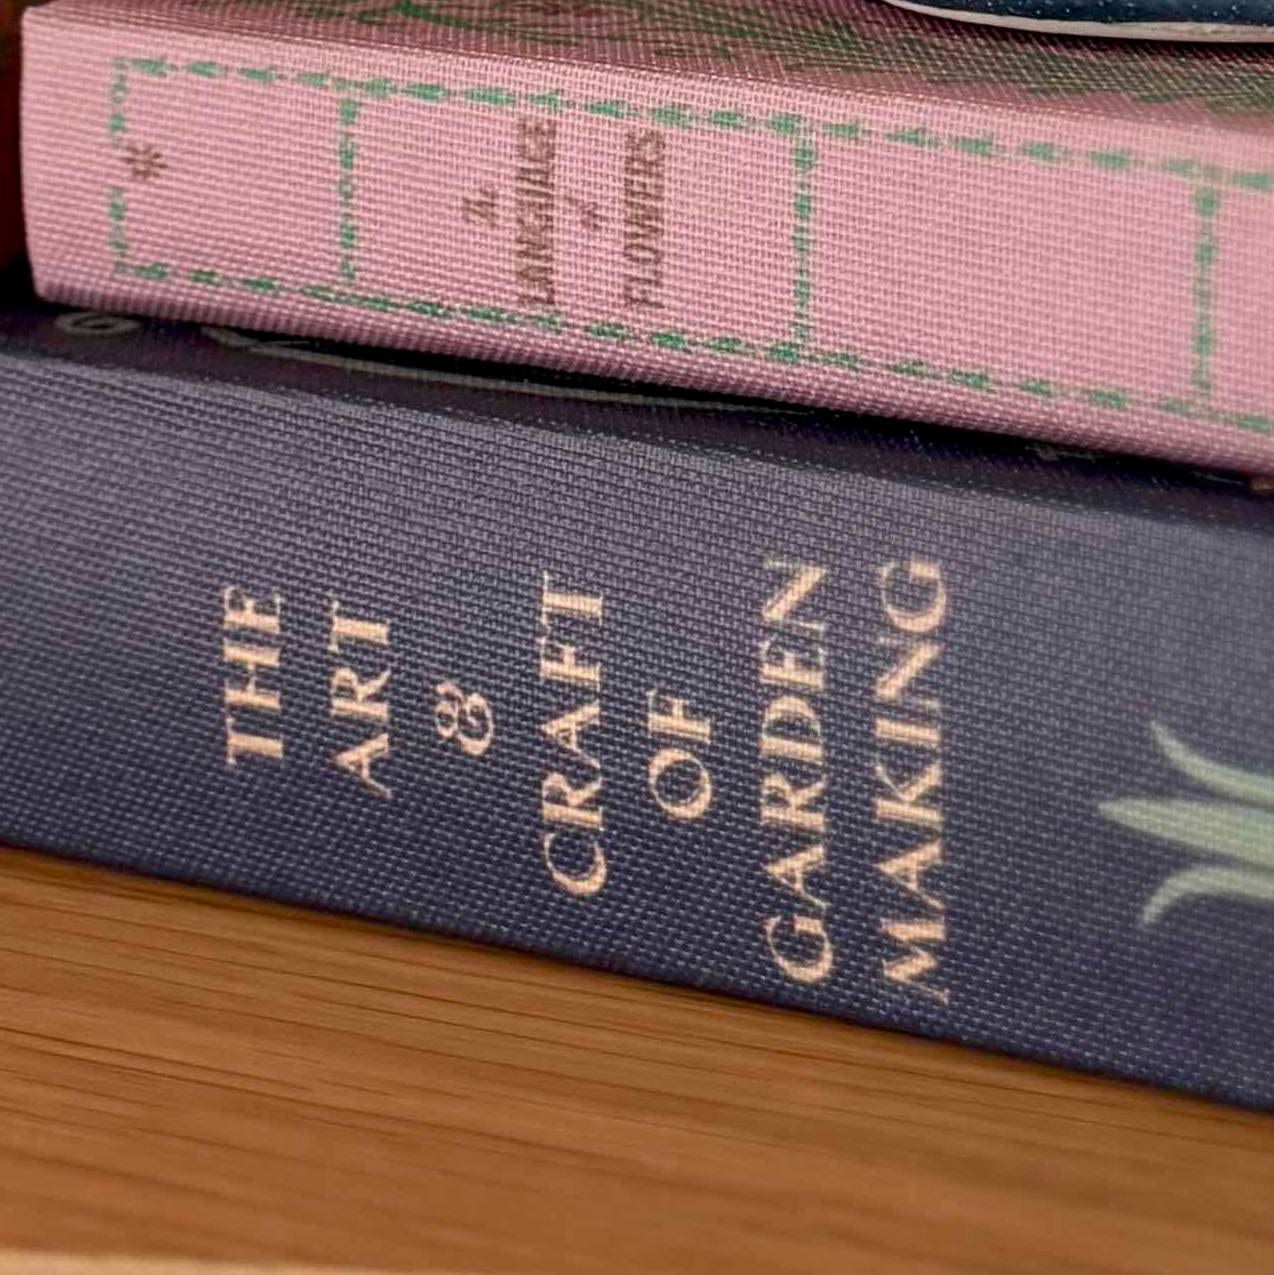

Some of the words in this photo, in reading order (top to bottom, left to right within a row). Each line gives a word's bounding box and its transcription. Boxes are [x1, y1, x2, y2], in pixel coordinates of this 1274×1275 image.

[624, 130, 665, 309] FLOWERS
[223, 586, 283, 768] THE
[330, 595, 392, 798] ART
[435, 679, 495, 757] &
[539, 570, 608, 897] CRAFT
[646, 689, 712, 821] OF
[759, 556, 834, 985] GARDEN
[875, 555, 950, 1004] MAKING
